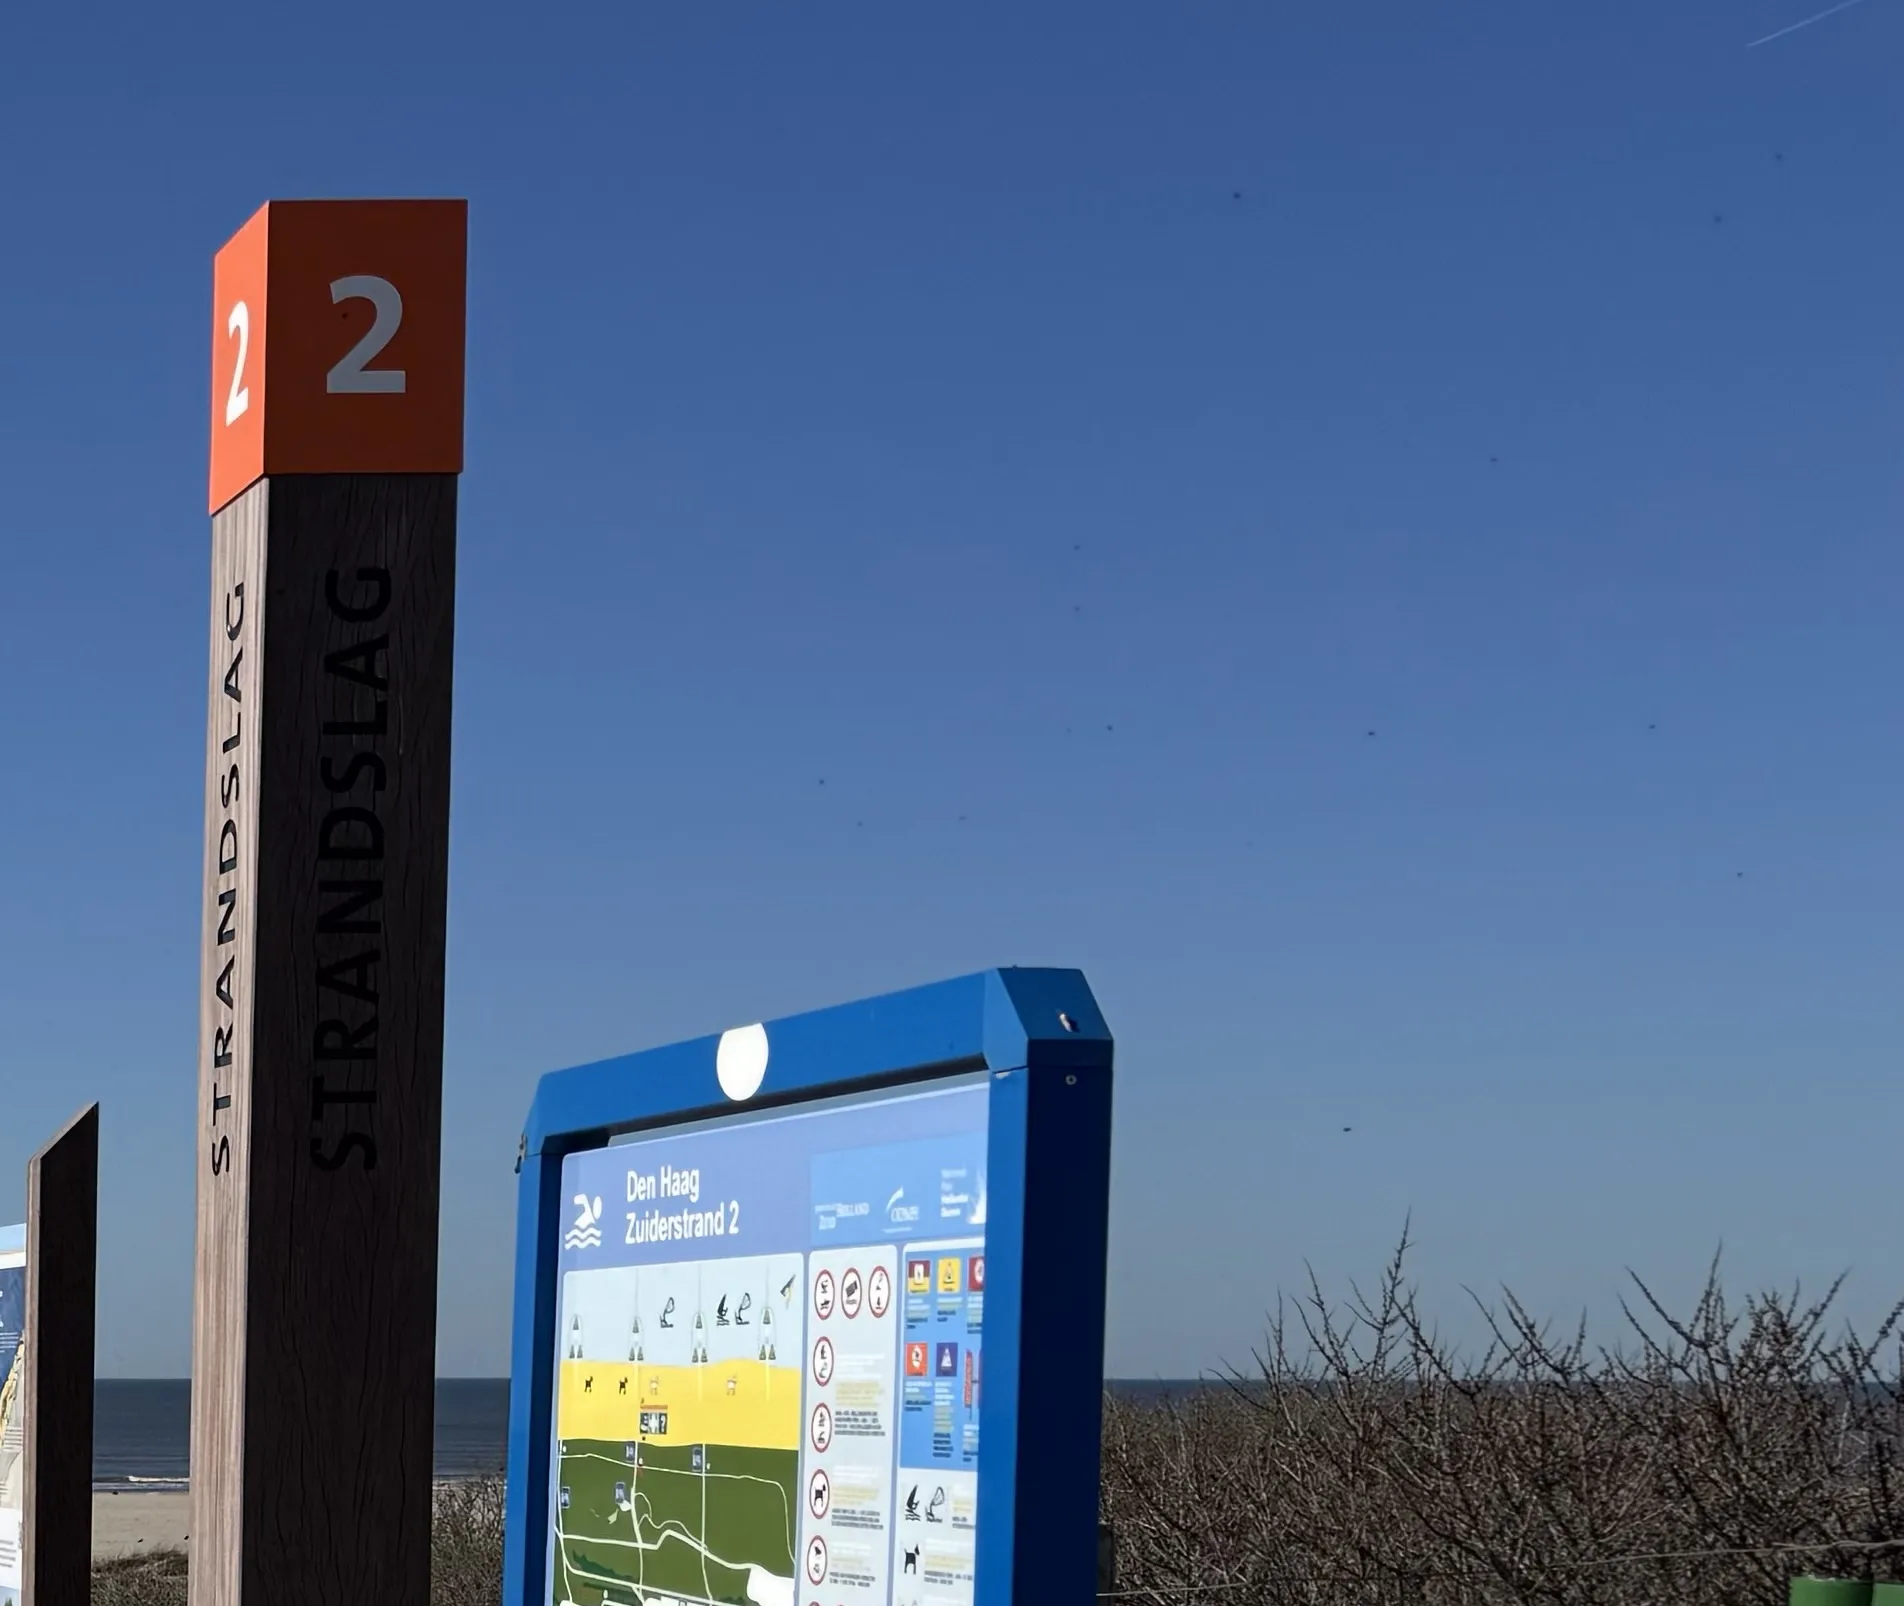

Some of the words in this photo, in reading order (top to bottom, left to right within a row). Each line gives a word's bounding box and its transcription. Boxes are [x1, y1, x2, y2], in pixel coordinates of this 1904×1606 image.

[226, 300, 249, 427] 2
[327, 275, 406, 393] 2
[212, 582, 245, 1176] STRANDSLAG
[310, 567, 392, 1171] STRANDSLAG
[625, 1201, 725, 1245] Zuiderstrand
[728, 1200, 740, 1235] 2
[626, 1170, 656, 1203] Den
[660, 1164, 700, 1203] Haag
